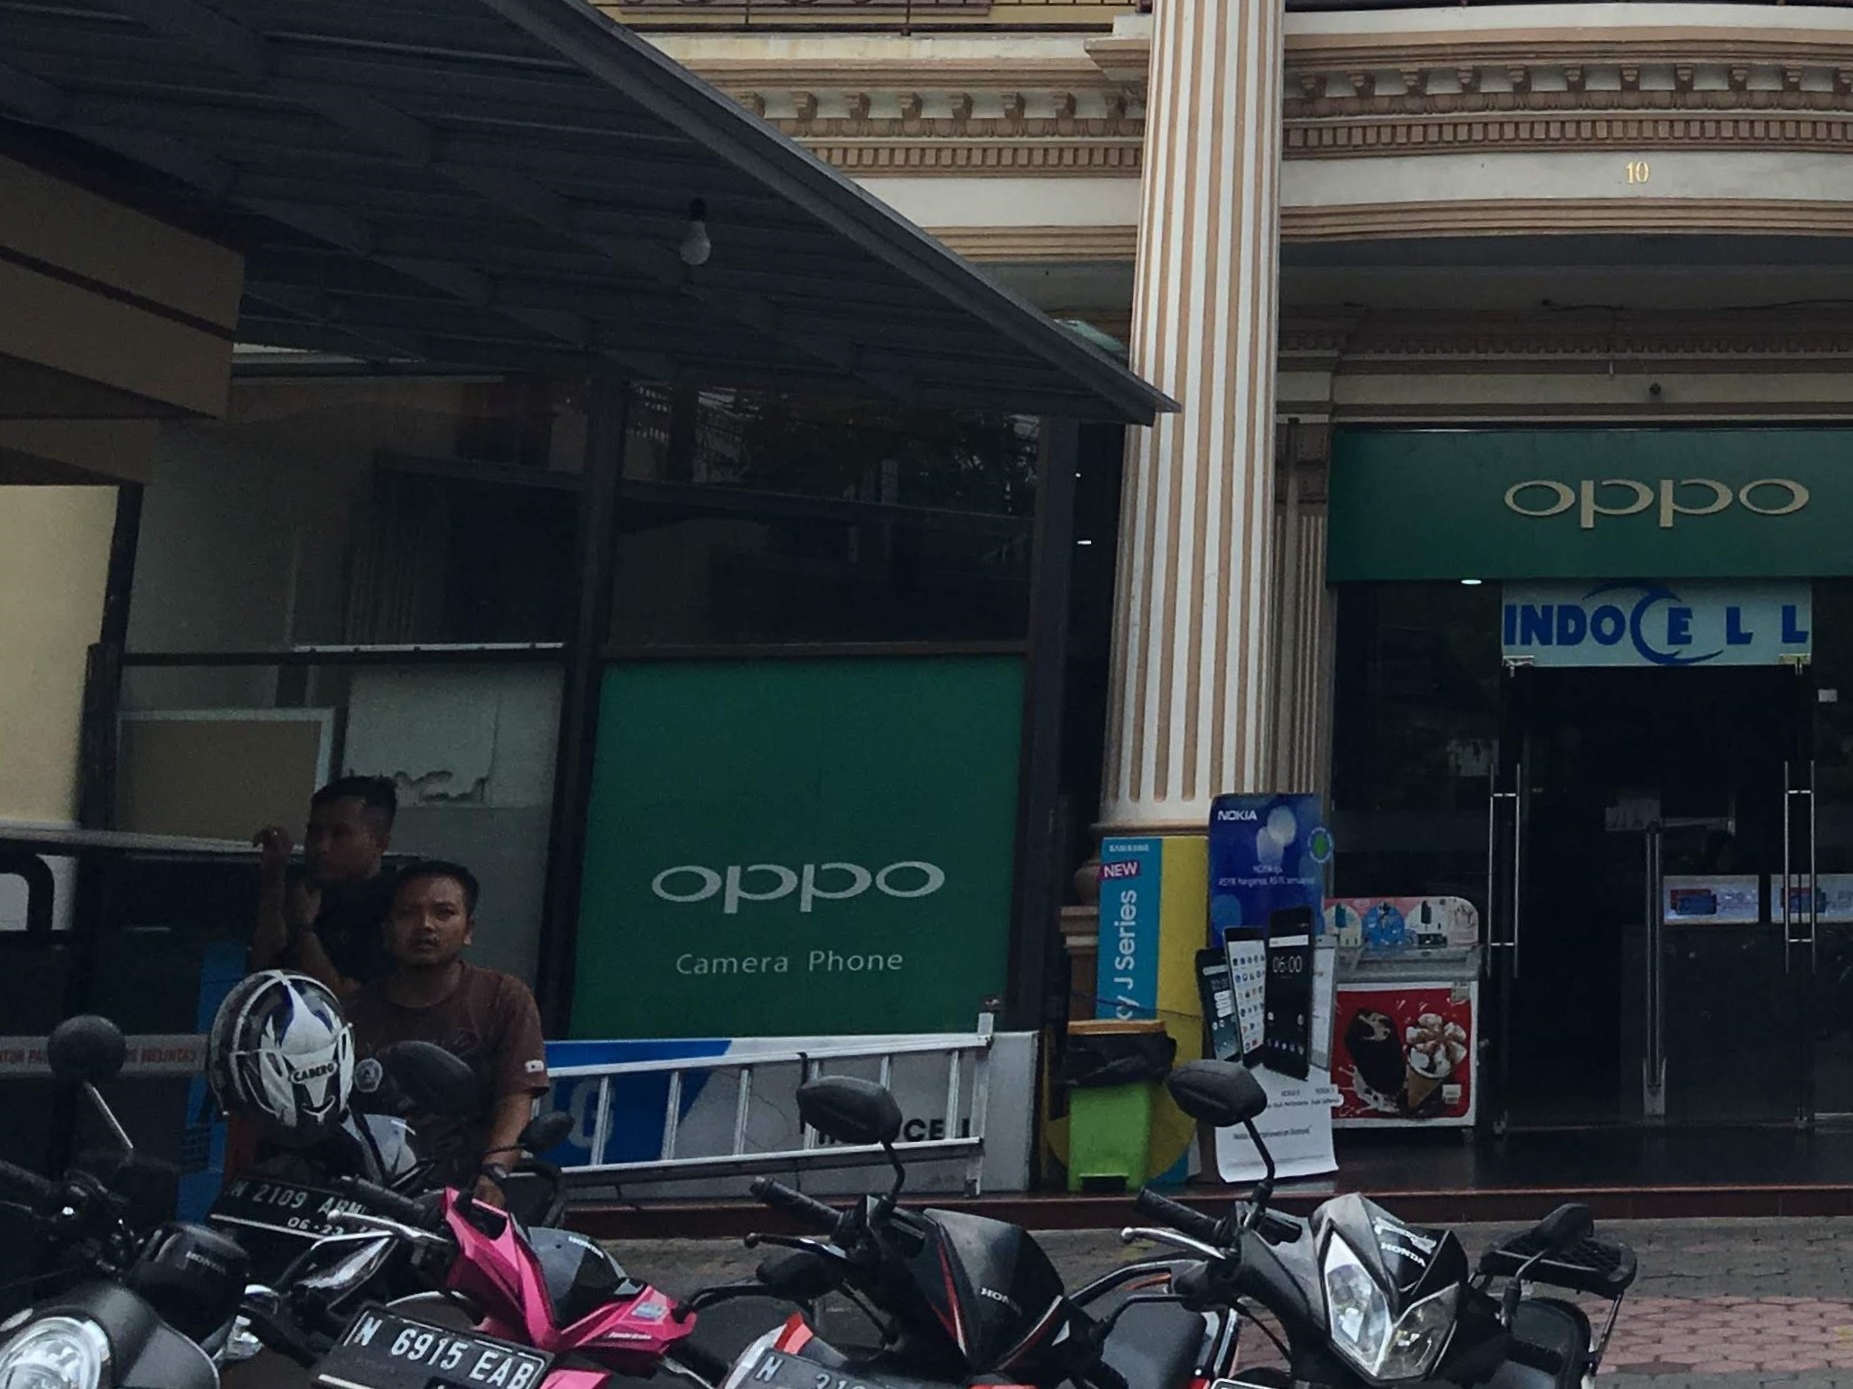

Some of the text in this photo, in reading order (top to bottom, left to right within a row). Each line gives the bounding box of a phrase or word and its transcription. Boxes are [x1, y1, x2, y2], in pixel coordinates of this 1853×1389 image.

[1626, 161, 1650, 184] 10
[1217, 810, 1258, 821] NOKIA
[1103, 862, 1138, 878] NEW
[1114, 889, 1137, 970] Series
[676, 950, 903, 975] Camera Phone
[1272, 955, 1304, 974] 06:00
[1113, 977, 1134, 990] J
[253, 1184, 308, 1208] 2109
[1381, 1242, 1426, 1267] HONDA
[354, 1316, 534, 1389] N 6915 EAB
[755, 1356, 783, 1382] N
